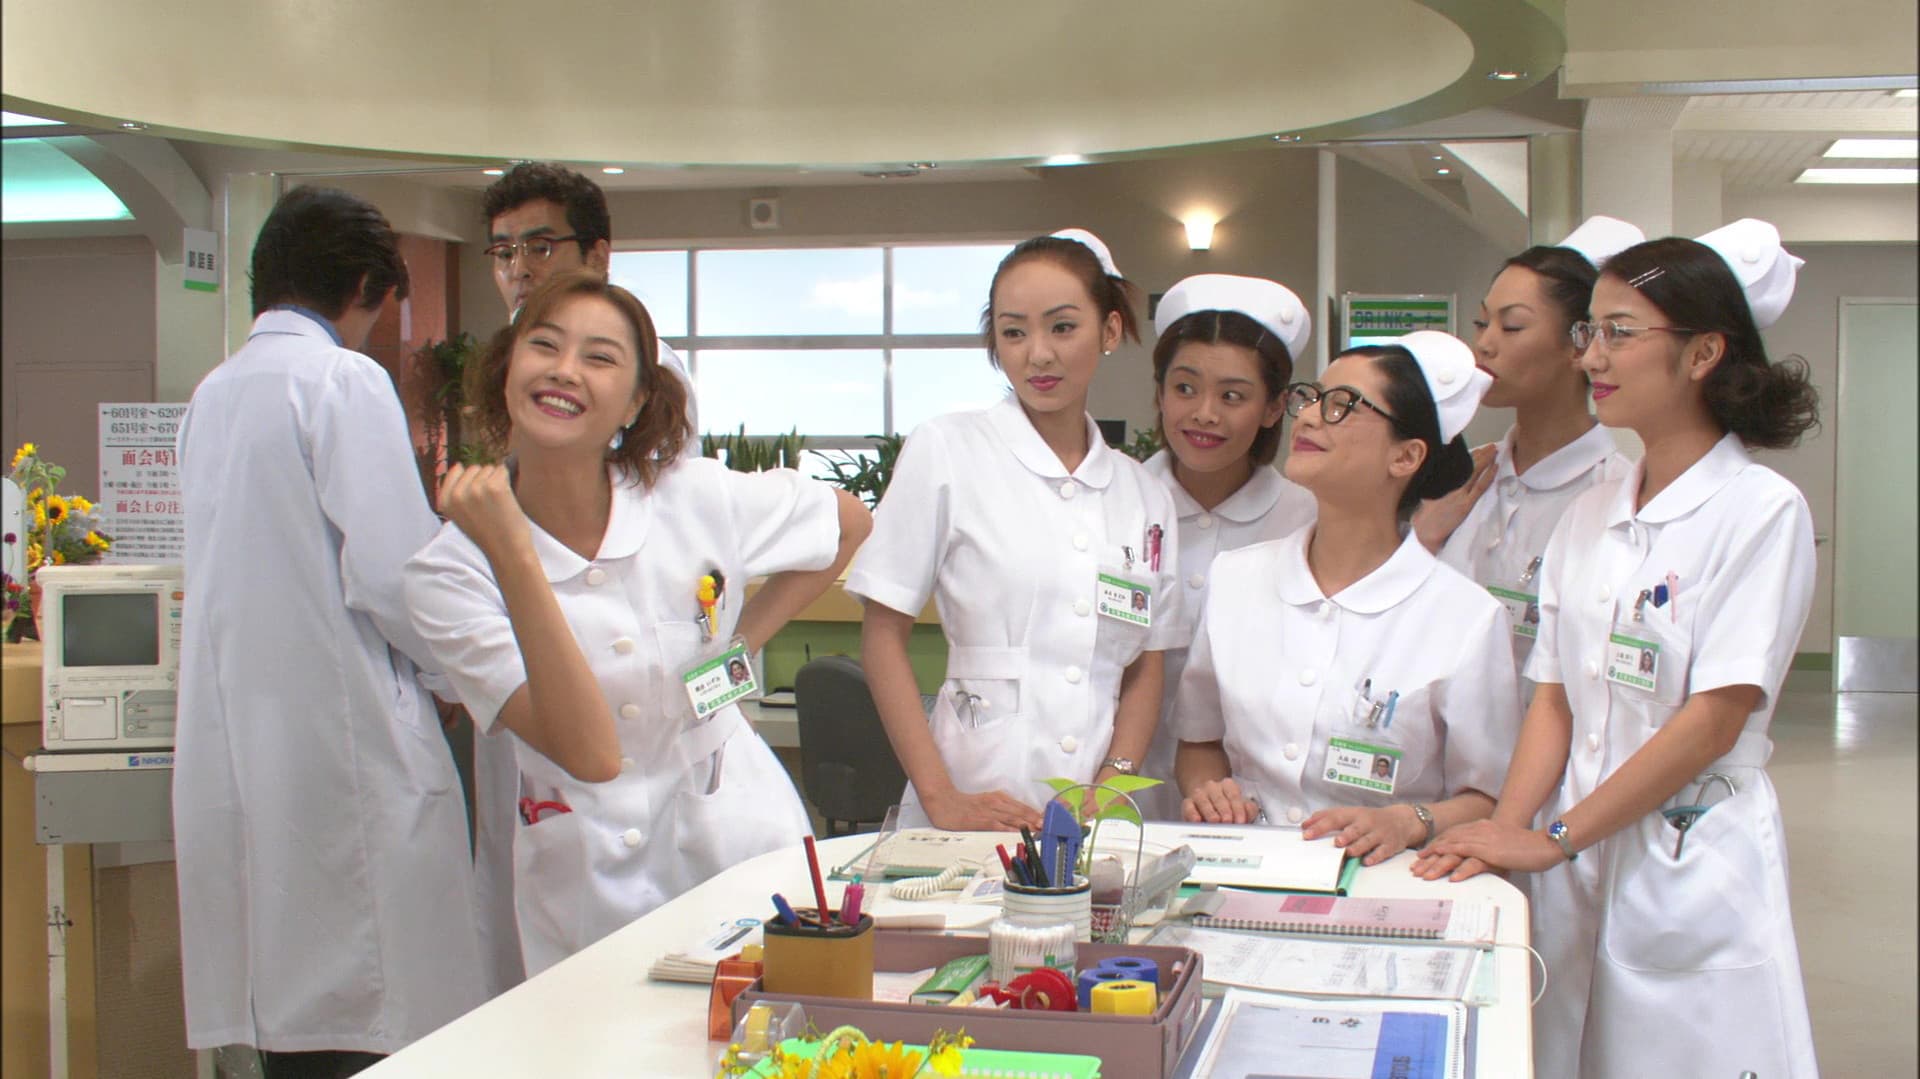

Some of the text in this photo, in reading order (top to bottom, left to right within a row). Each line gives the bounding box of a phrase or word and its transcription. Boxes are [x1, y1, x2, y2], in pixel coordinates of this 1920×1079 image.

[116, 500, 184, 514] 面会上の注
